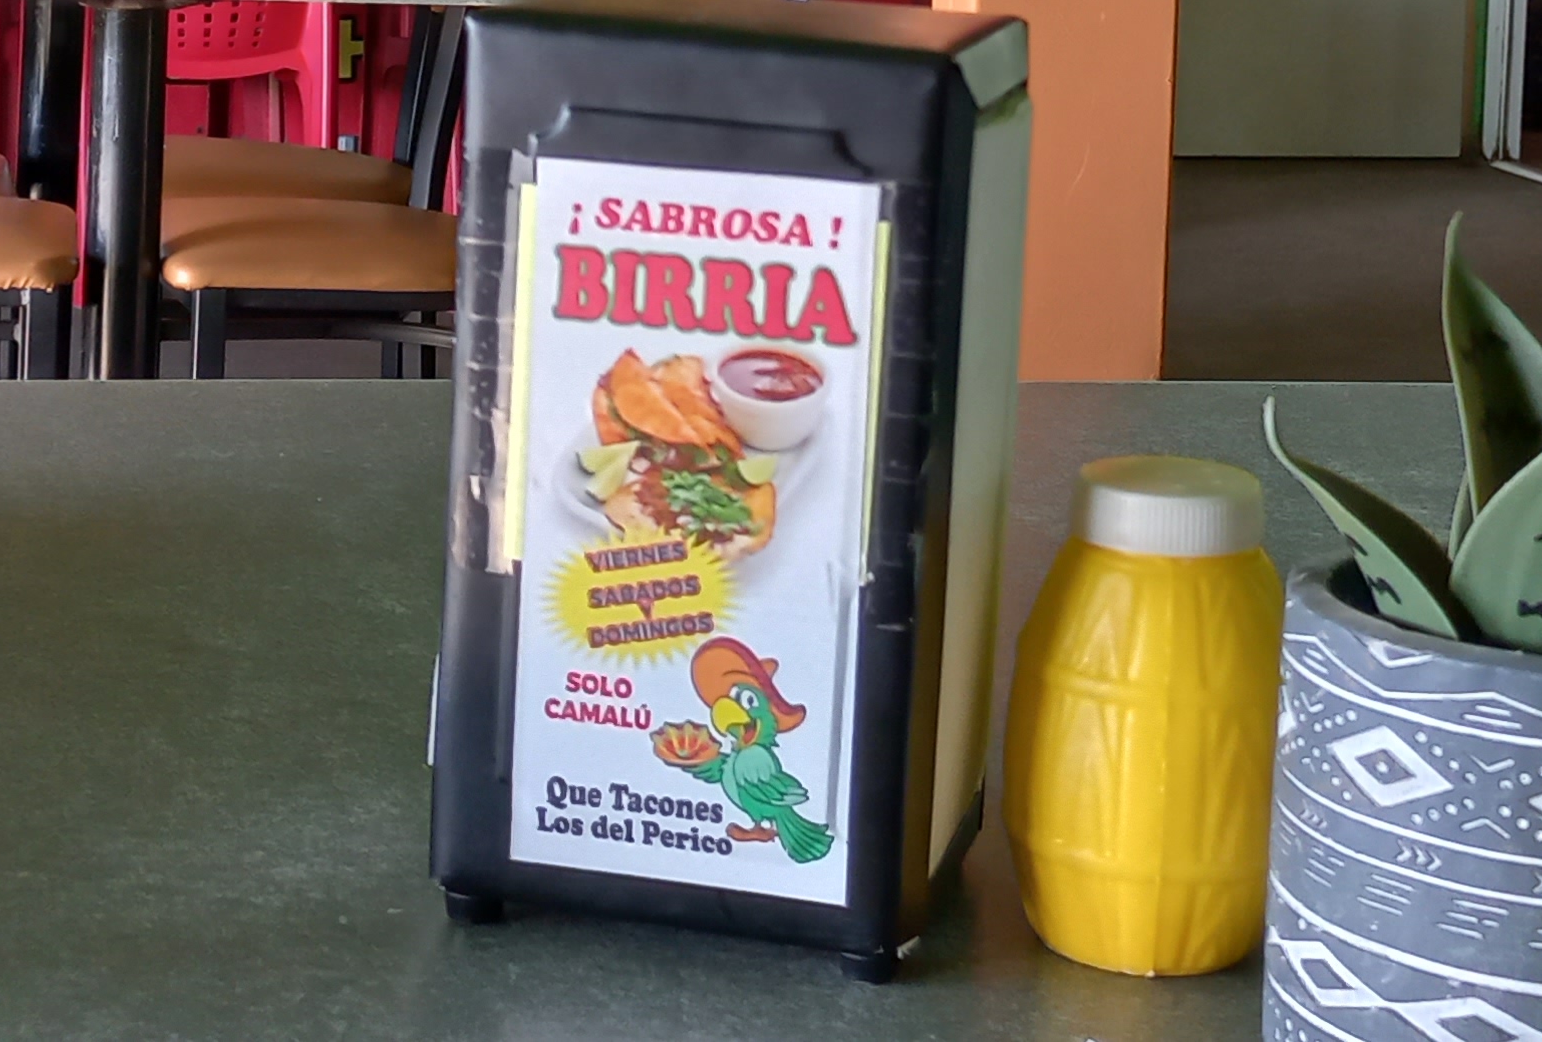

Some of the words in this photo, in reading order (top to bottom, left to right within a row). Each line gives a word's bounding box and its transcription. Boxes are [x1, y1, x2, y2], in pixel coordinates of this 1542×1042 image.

[594, 196, 815, 248] SABROSA
[552, 242, 858, 346] BIRRIA
[585, 541, 688, 572] VIERNES
[587, 574, 702, 609] SABADOS
[587, 611, 715, 648] DOMINGOS
[565, 671, 633, 699] SOLO
[544, 698, 652, 730] CAMALÚ
[546, 775, 602, 810] Que
[609, 782, 724, 824] Tacones
[535, 806, 584, 836] Los
[590, 815, 635, 843] del
[641, 820, 733, 855] Perico
